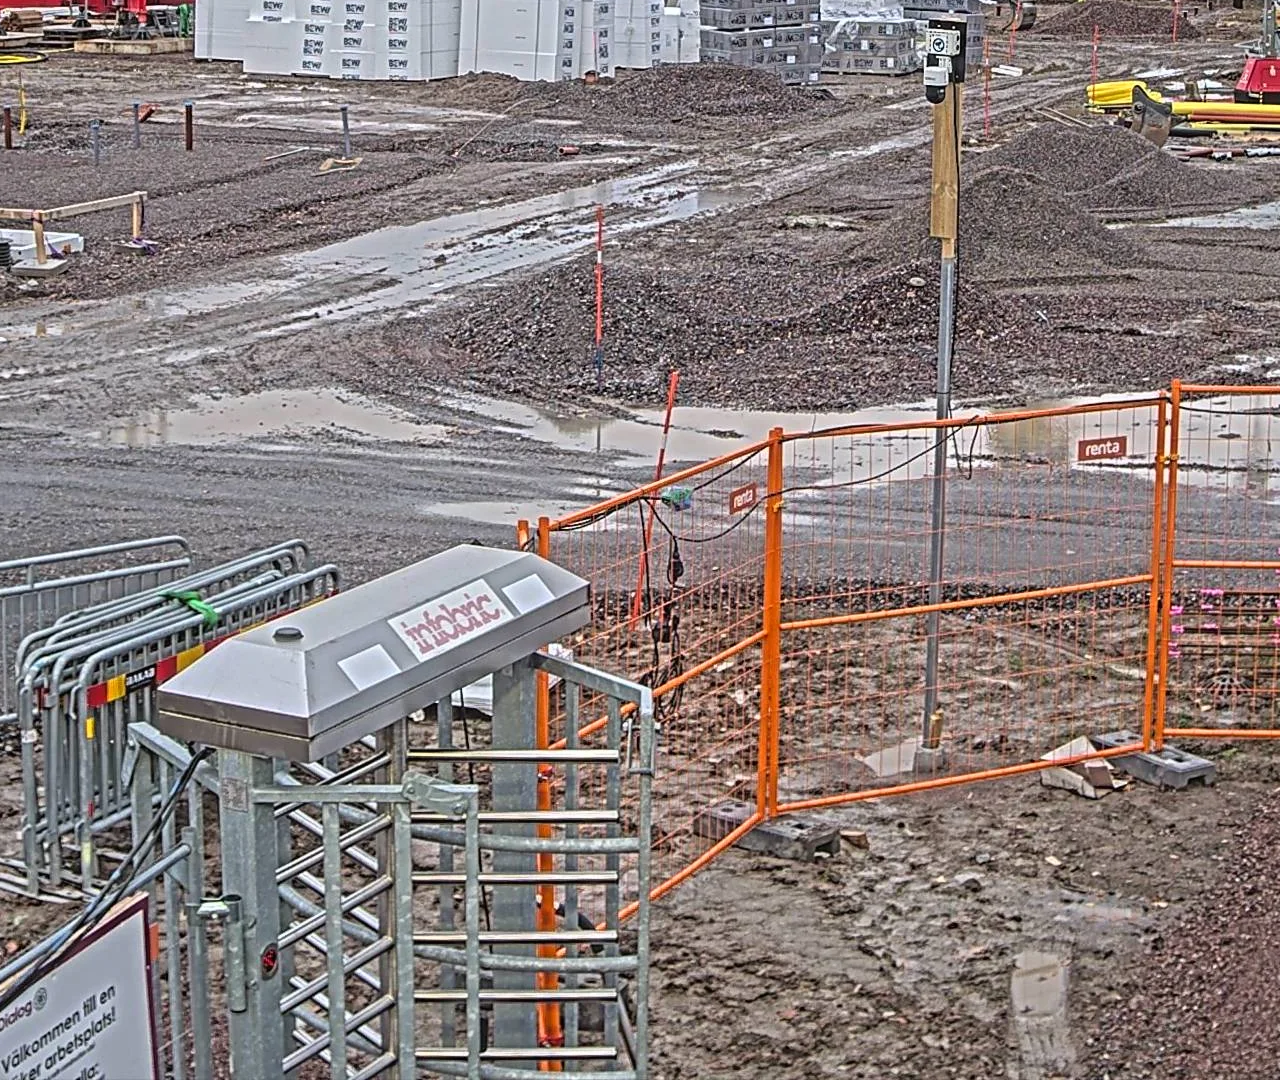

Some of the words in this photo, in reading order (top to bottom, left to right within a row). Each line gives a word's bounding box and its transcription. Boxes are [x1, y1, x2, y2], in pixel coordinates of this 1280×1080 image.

[311, 5, 331, 14] BEWI
[388, 2, 408, 10] BEWI
[305, 24, 325, 33] BEWI
[388, 39, 408, 48] BEWI
[388, 59, 408, 68] BEWI
[1085, 440, 1121, 457] renta
[732, 489, 754, 509] renta
[401, 592, 501, 655] infobric
[0, 1011, 81, 1073] Välkommen
[83, 995, 97, 1017] till
[99, 984, 116, 1005] en
[44, 1006, 116, 1070] arbetsplats!
